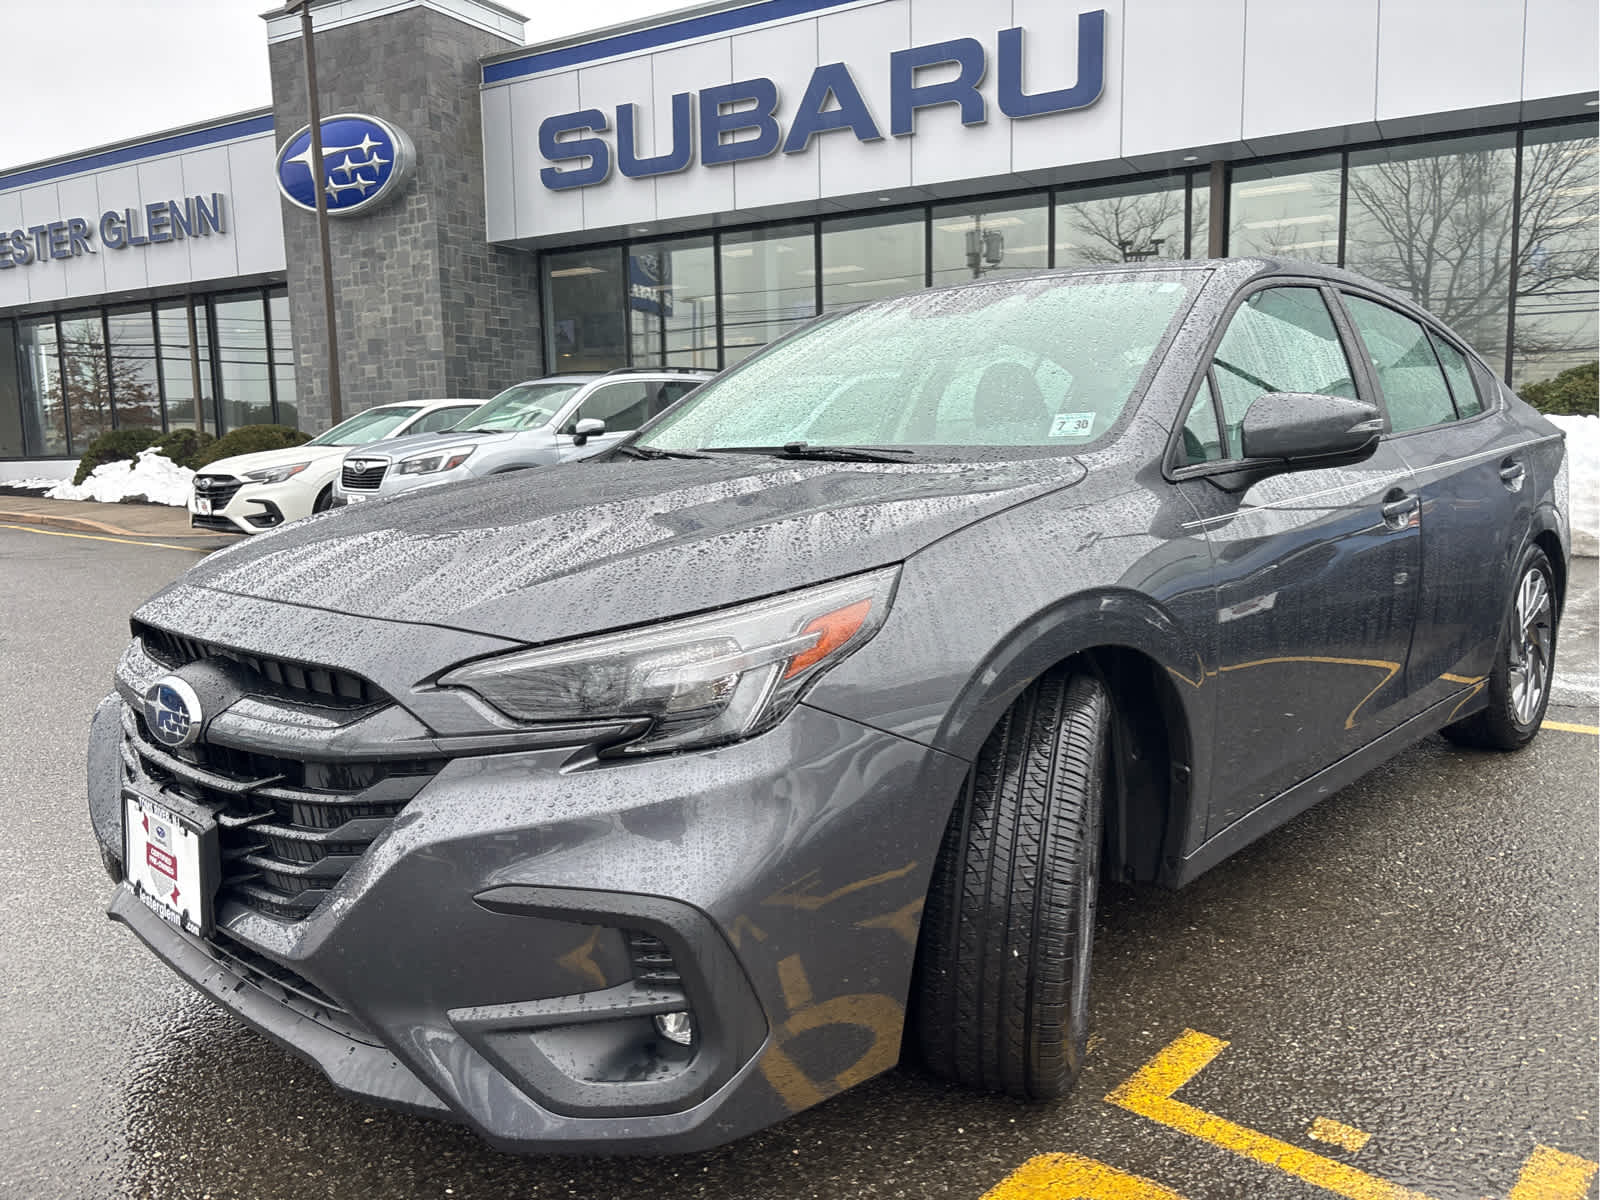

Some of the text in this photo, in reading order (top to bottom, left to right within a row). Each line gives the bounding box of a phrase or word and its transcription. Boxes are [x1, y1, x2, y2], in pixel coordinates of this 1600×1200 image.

[538, 8, 1106, 192] SUBARU
[99, 192, 224, 249] GLENN
[1056, 419, 1089, 431] 7 30
